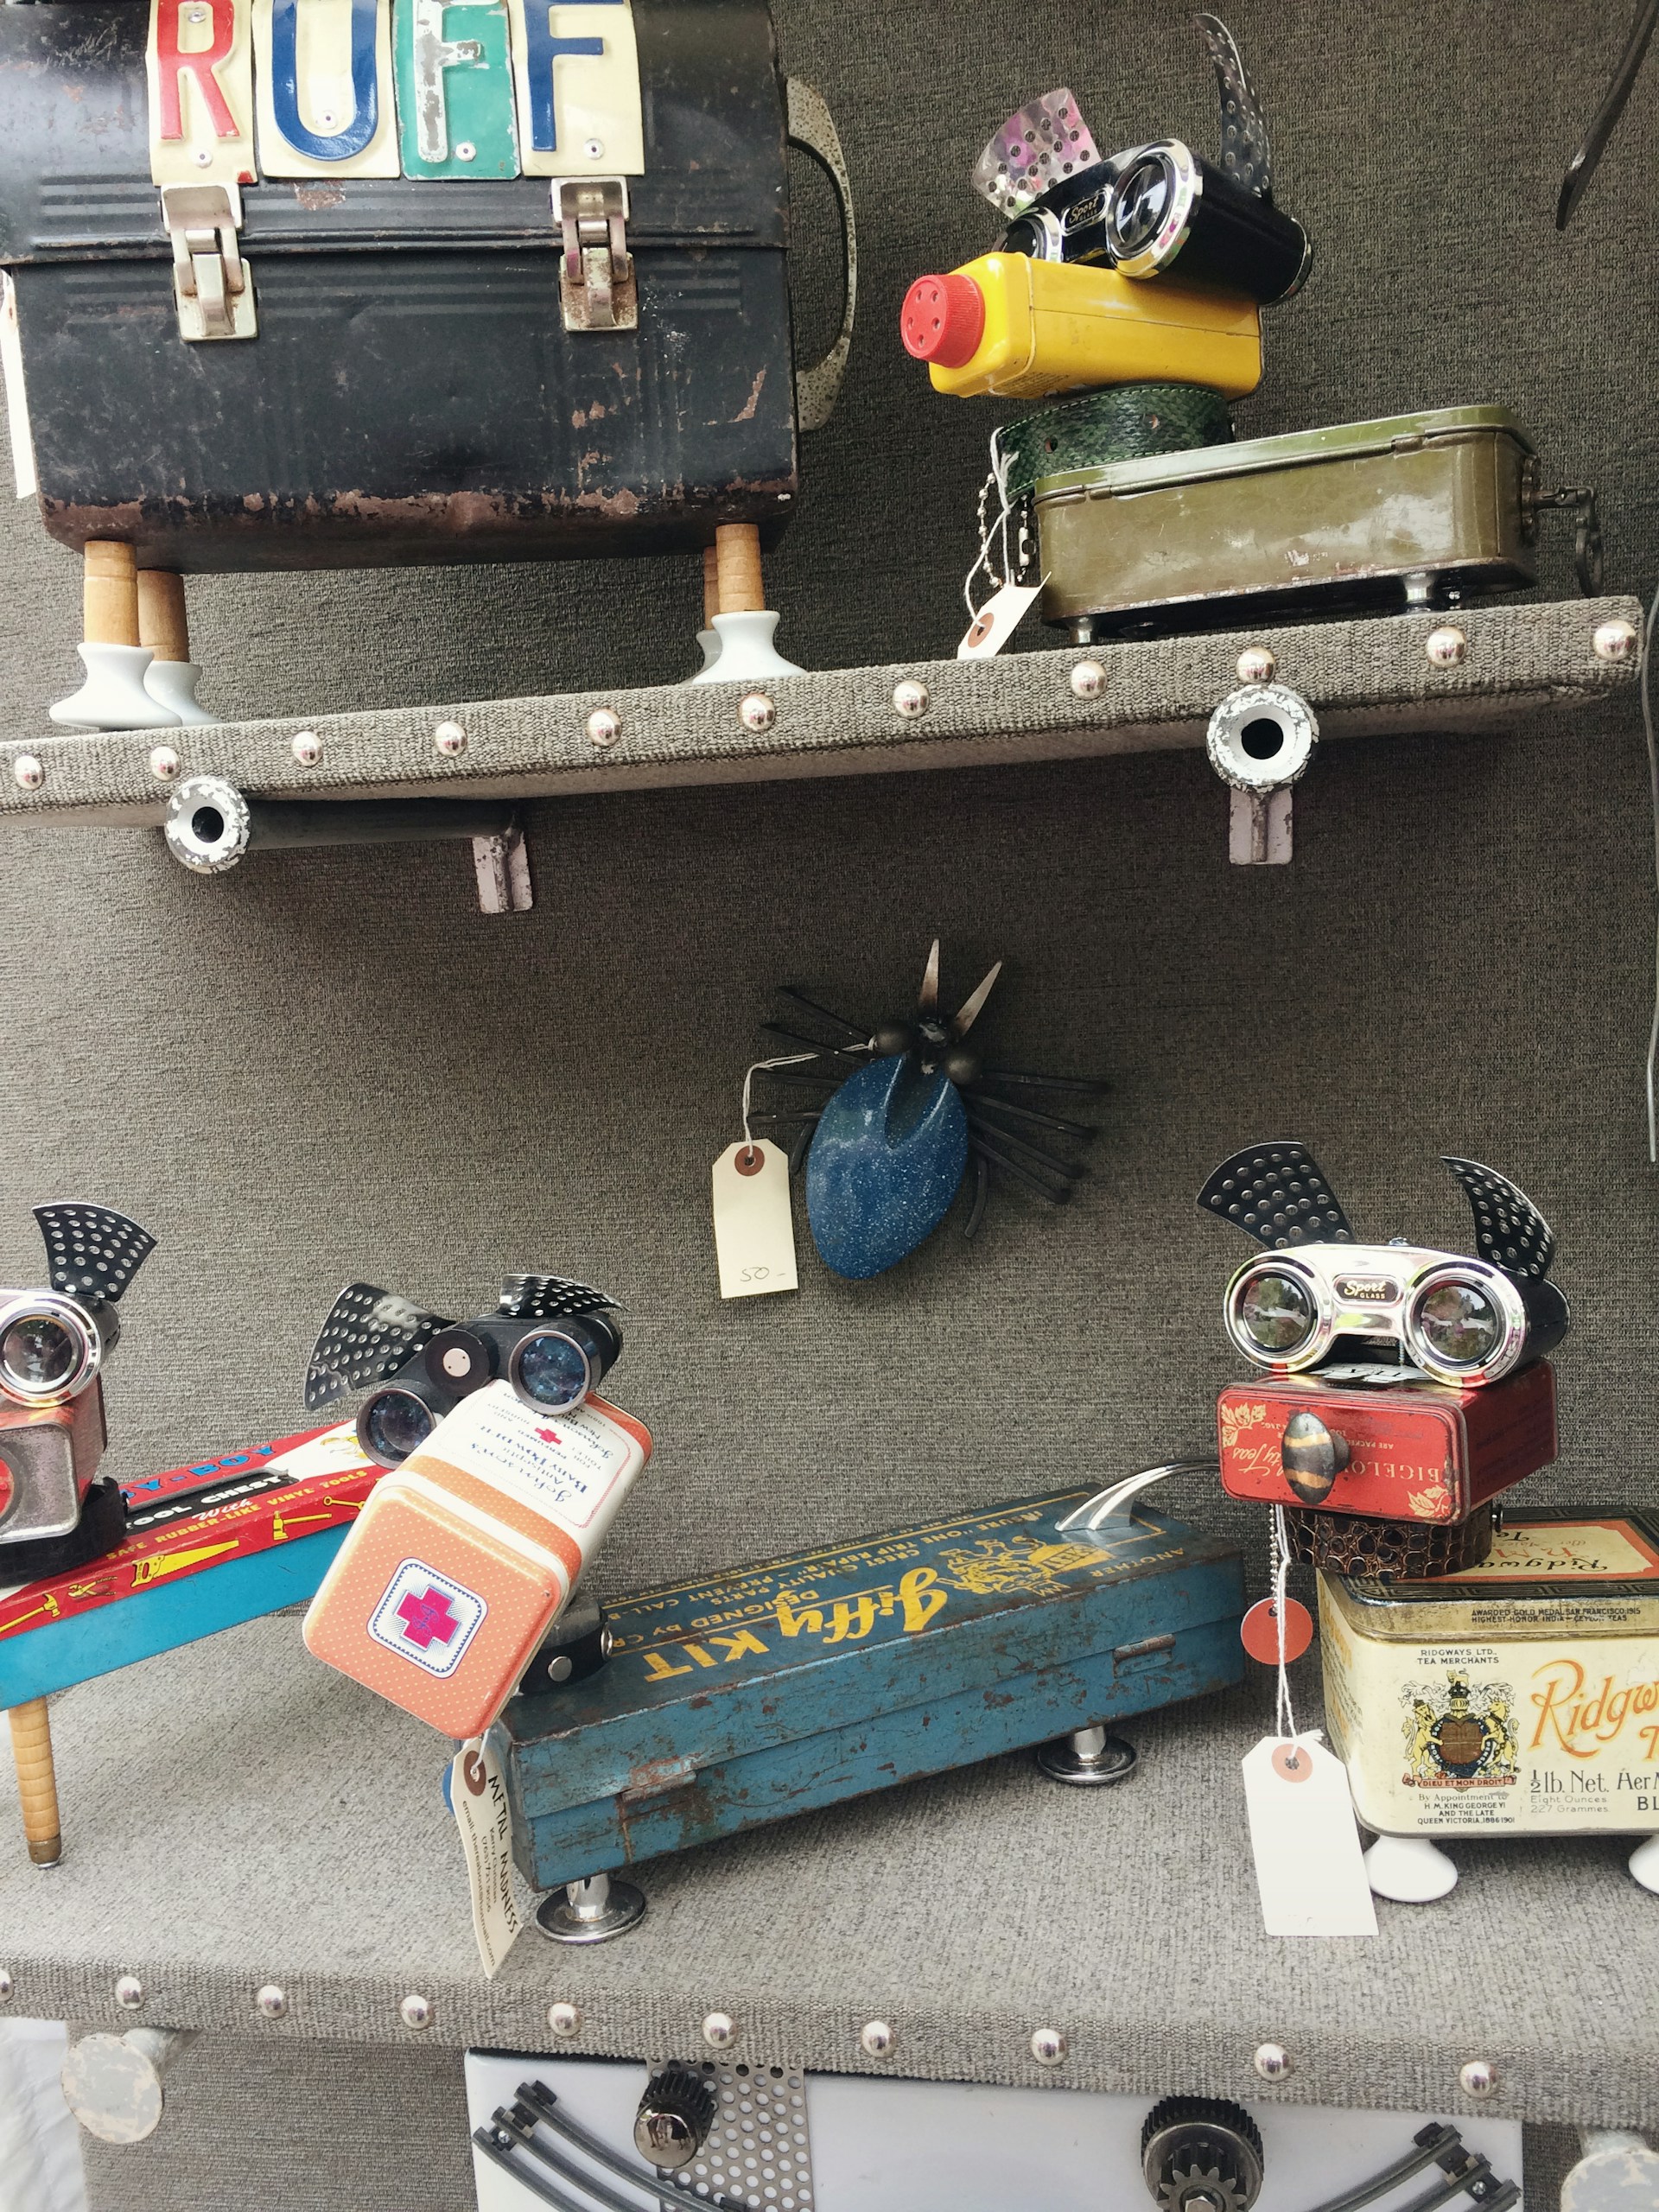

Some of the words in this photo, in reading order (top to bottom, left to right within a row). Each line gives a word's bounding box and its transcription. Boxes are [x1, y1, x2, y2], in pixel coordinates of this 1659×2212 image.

[157, 0, 622, 162] RUFF
[1069, 194, 1099, 224] Sport
[1344, 1280, 1387, 1296] Sport
[1232, 1443, 1270, 1477] Teas
[1344, 1460, 1440, 1483] BIGELO
[200, 1475, 283, 1504] CHEST
[105, 1541, 148, 1560] SAFE
[154, 1503, 263, 1544] RUBBER-LIKE
[266, 1486, 315, 1507] VINYL
[318, 1470, 368, 1491] TOOLS
[190, 1498, 254, 1522] With
[866, 1549, 920, 1567] CREST
[877, 1541, 918, 1555] TRIP
[709, 1586, 770, 1606] PARTS
[691, 1590, 820, 1629] DESIGNED
[643, 1630, 770, 1682] KIT
[1570, 1770, 1610, 1793] Net.
[1617, 1771, 1651, 1791] Her
[487, 1775, 508, 1841] METAL
[1419, 1794, 1430, 1802] By
[1433, 1794, 1496, 1802] Appointment
[1530, 1795, 1561, 1806] Eight
[462, 1800, 475, 1833] email:
[499, 1851, 518, 1934] MADNESS
